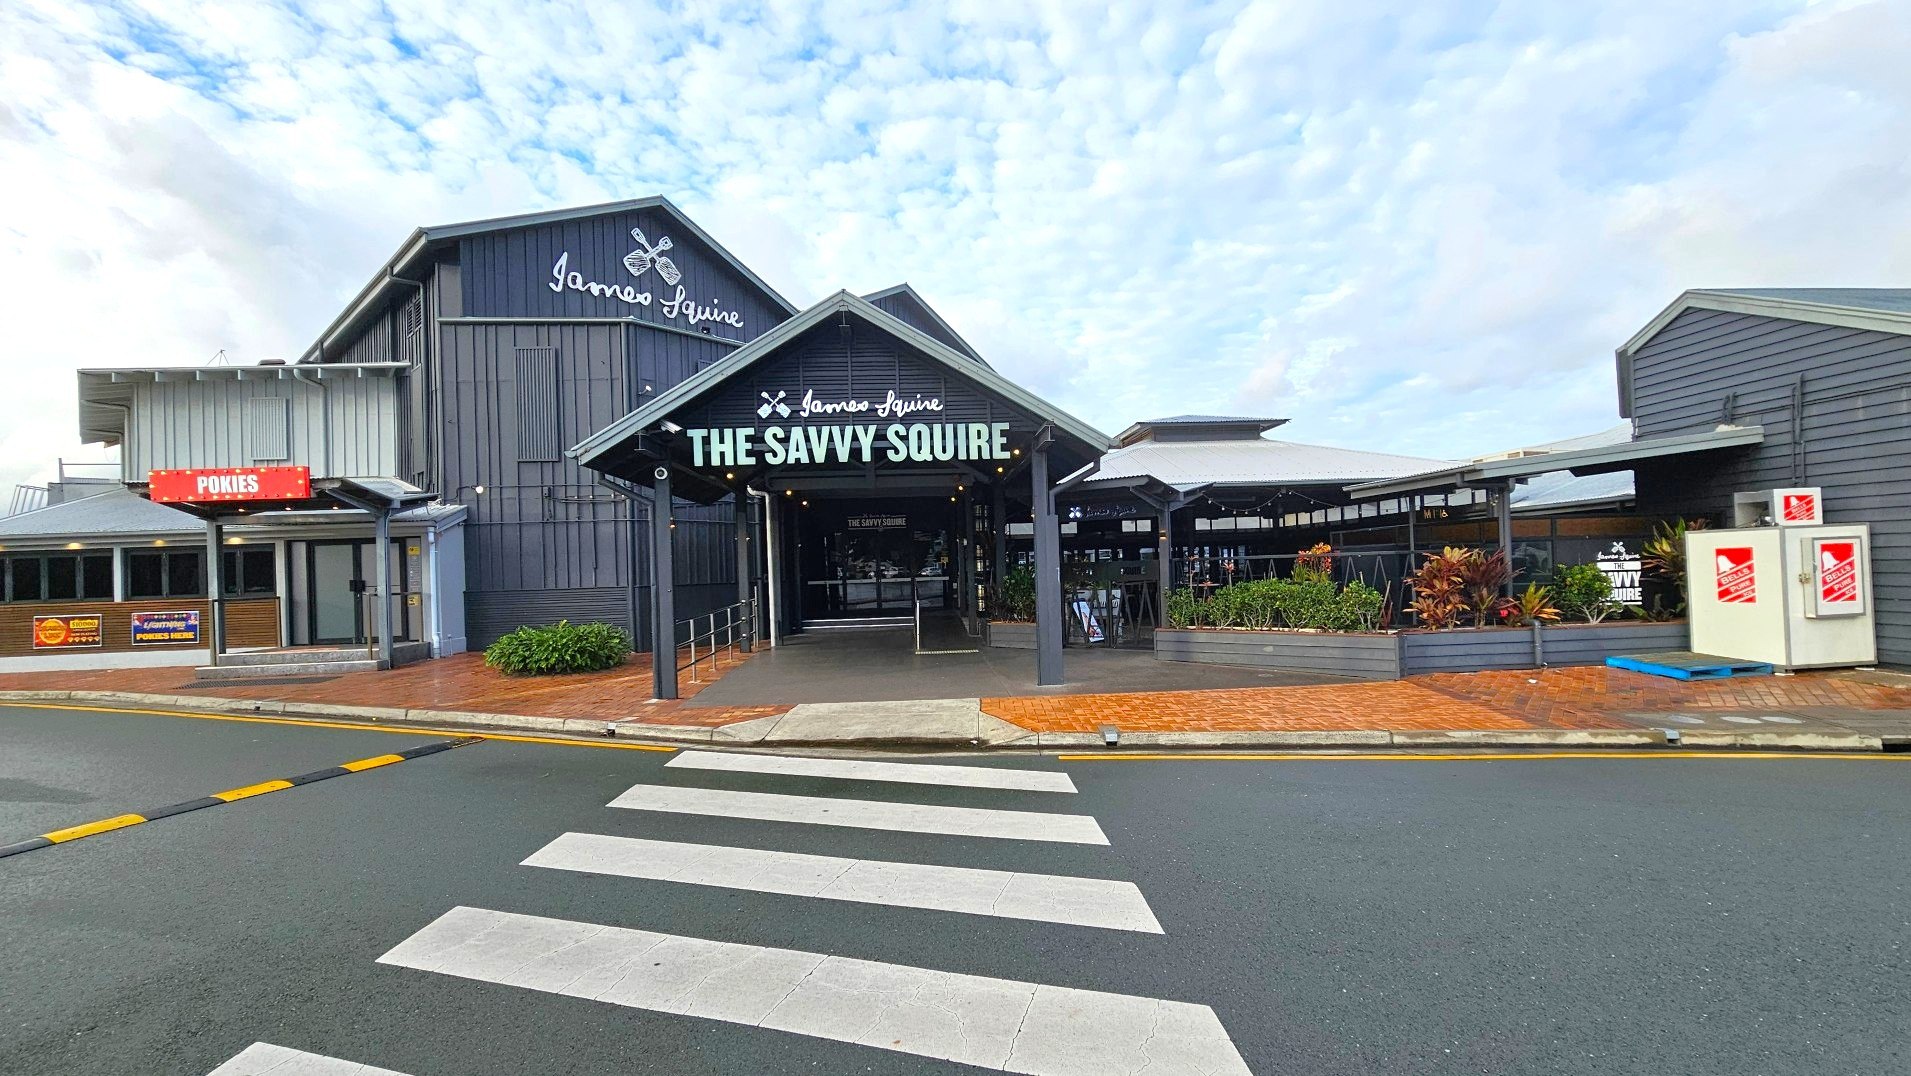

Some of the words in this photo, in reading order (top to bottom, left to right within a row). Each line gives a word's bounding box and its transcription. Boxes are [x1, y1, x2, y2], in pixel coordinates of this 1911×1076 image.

[549, 251, 652, 306] James
[660, 284, 744, 328] Squire
[799, 388, 868, 417] James
[875, 389, 944, 418] Squire
[686, 428, 757, 467] THE
[763, 424, 878, 465] SAVVY
[886, 422, 1011, 463] SQUIRE
[197, 474, 259, 494] POKIES
[848, 519, 861, 527] THE
[861, 518, 882, 527] SAVVY
[882, 517, 907, 526] SQUIRE
[1613, 562, 1625, 570] THE
[1825, 564, 1851, 583] BELLS
[1721, 567, 1750, 585] BELLS
[1834, 577, 1852, 591] PURE
[1730, 580, 1752, 593] PURE
[136, 632, 170, 641] POKIES
[170, 631, 195, 640] HERE
